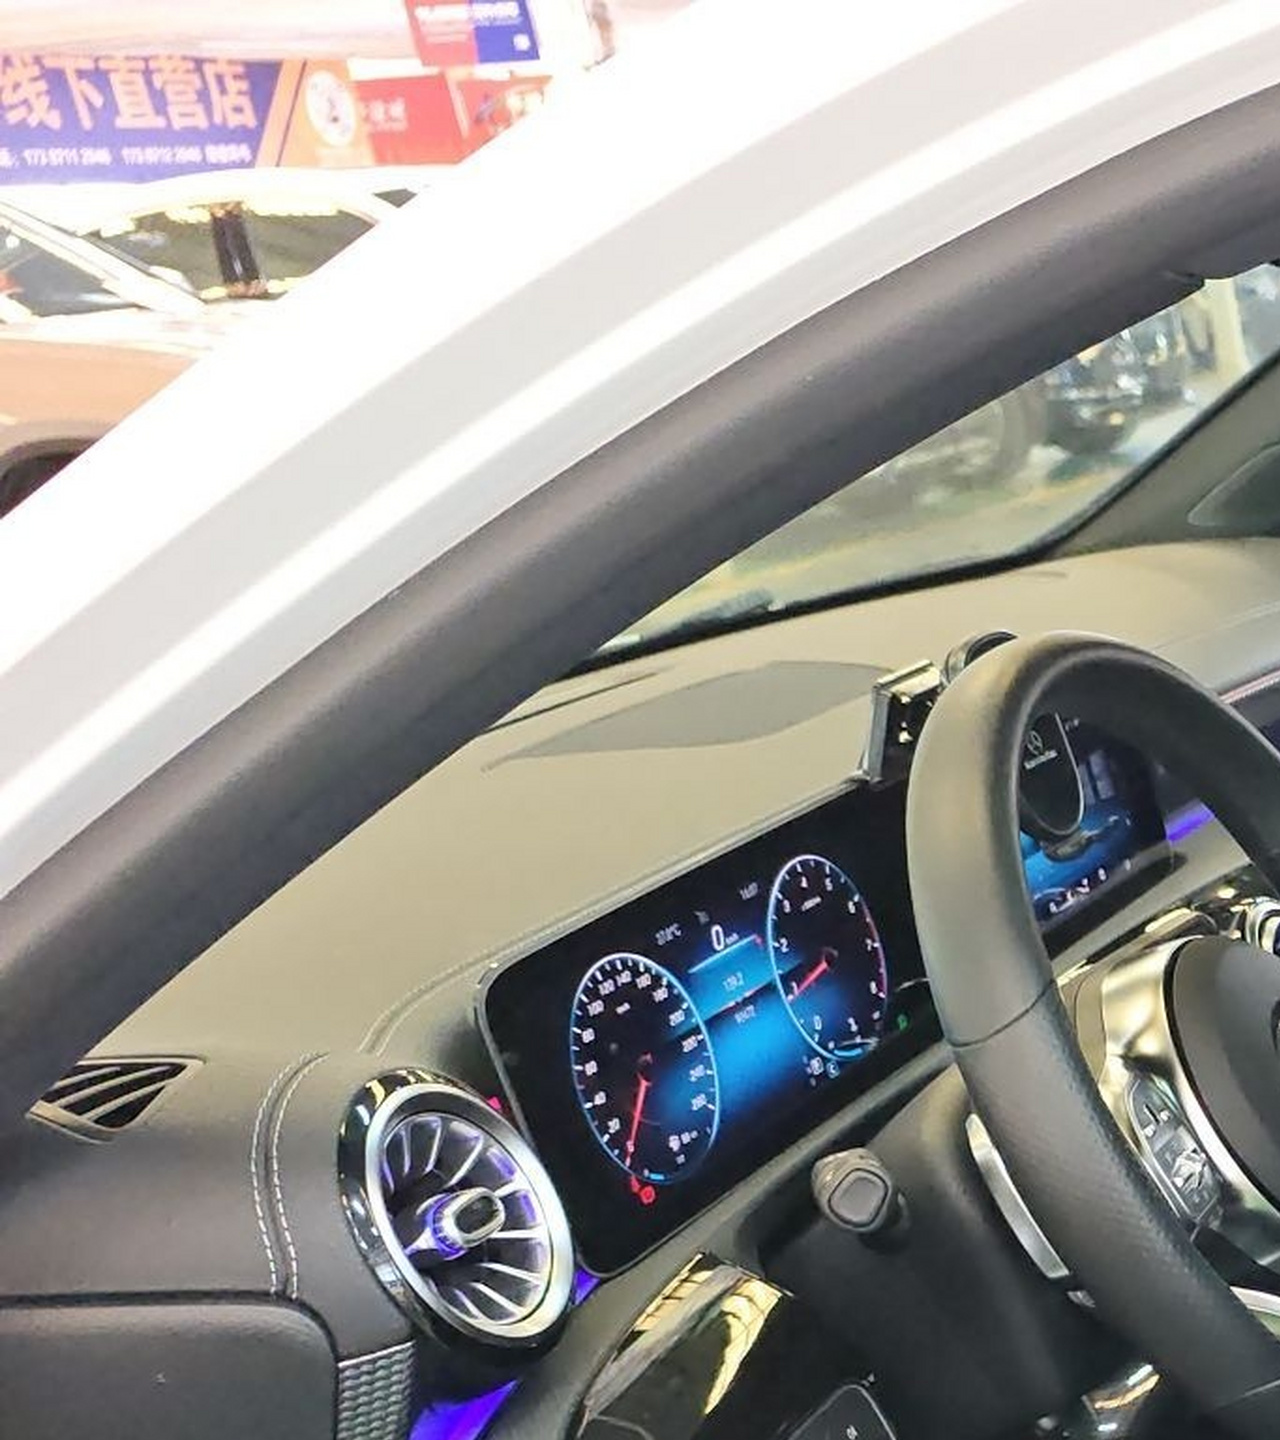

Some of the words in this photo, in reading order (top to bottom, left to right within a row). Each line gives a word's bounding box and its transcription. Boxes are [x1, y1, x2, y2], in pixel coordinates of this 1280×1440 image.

[0, 54, 257, 130] 线下直营店
